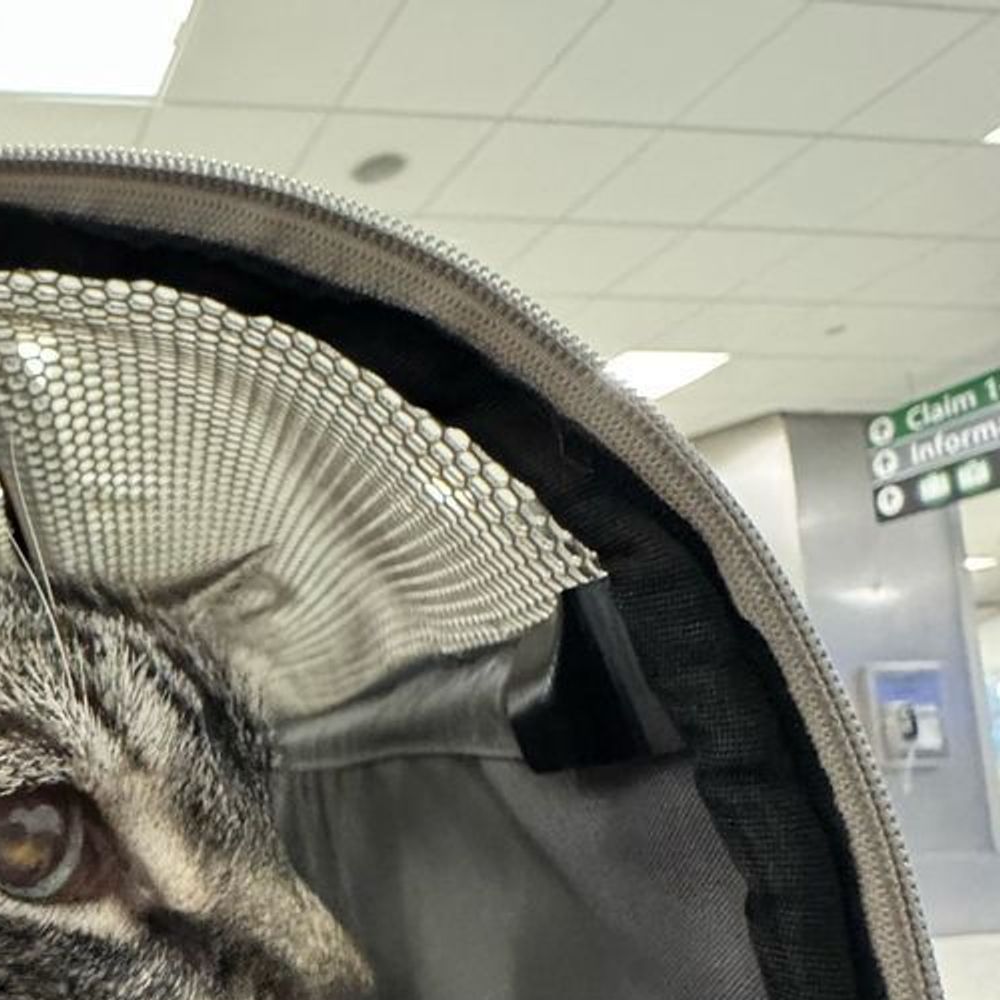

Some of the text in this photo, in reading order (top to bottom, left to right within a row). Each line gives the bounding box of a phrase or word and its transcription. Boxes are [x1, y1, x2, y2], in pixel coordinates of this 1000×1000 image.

[905, 376, 1000, 432] Claim 1
[911, 418, 1000, 466] Inform
